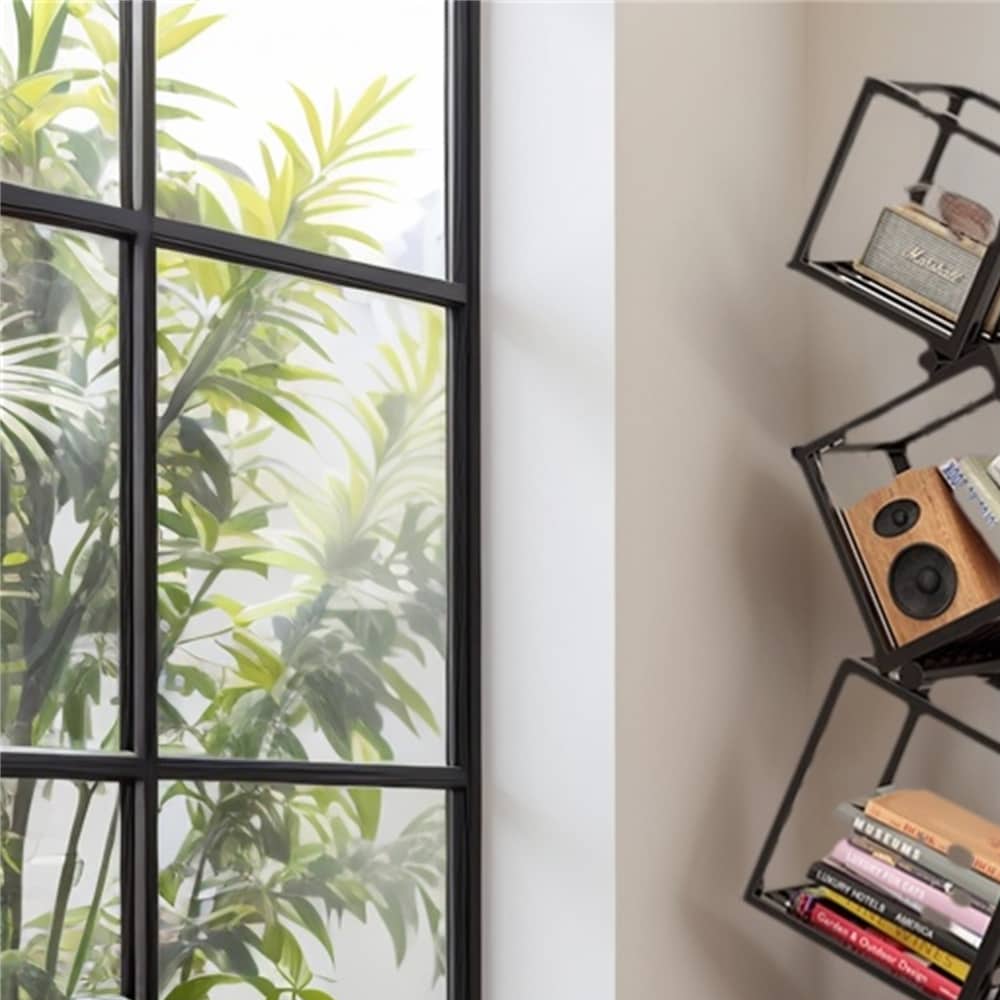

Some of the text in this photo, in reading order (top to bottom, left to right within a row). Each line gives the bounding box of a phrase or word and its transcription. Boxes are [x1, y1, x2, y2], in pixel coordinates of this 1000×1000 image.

[853, 816, 921, 860] MUSEUMS
[815, 870, 886, 913] LUXURY HOTELS
[895, 911, 934, 938] AMERICA
[816, 911, 929, 984] Garden & Outdoor Design
